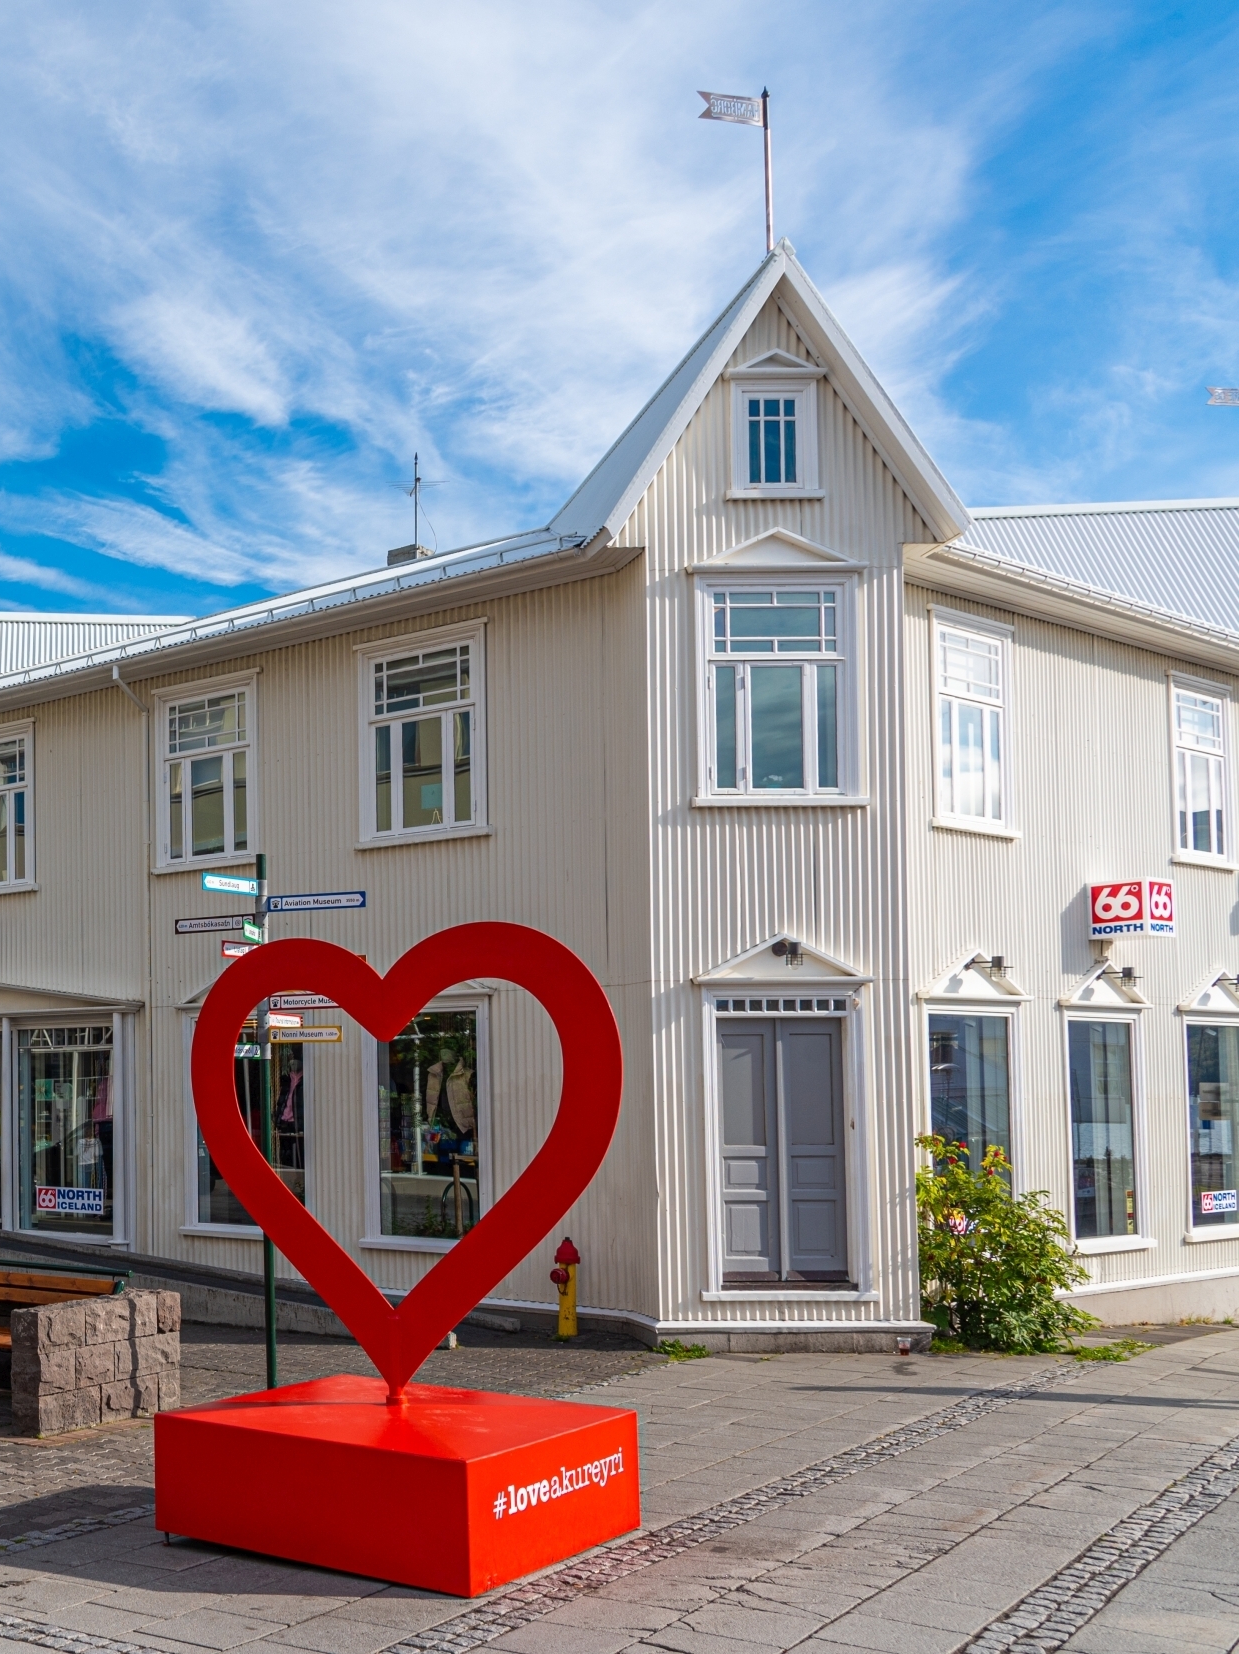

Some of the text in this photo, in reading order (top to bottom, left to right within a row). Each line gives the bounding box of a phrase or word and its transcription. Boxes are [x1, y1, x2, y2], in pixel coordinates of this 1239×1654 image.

[218, 879, 240, 890] Sundlaug
[284, 899, 311, 907] Aviation
[188, 919, 231, 929] Amtsbókasafn
[1092, 923, 1144, 935] NORTH
[1150, 923, 1173, 933] NORTH
[283, 998, 316, 1006] Motorcycle
[57, 1188, 102, 1201] NORTH
[1213, 1192, 1235, 1202] NORTH
[57, 1201, 102, 1212] ICELAND
[493, 1447, 624, 1520] #loveakureyri
